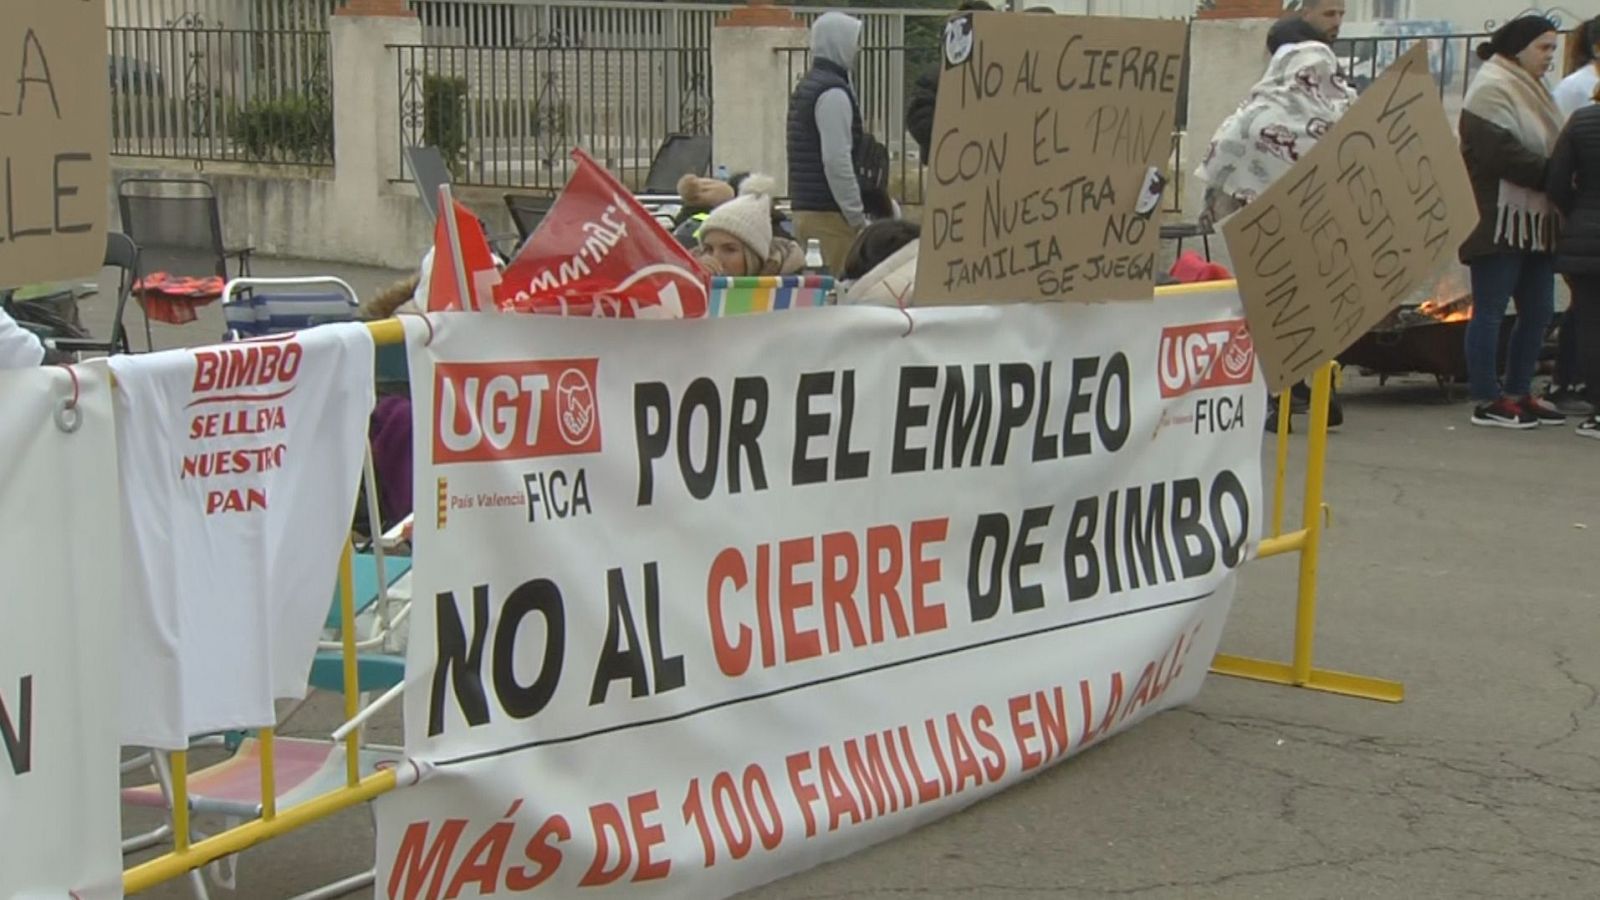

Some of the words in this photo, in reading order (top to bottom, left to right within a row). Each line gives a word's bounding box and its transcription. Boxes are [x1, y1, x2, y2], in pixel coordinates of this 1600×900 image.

[961, 40, 1004, 109] NO
[1013, 50, 1043, 96] AL
[1056, 35, 1181, 93] CIERRE
[934, 127, 1008, 186] CON
[1033, 107, 1070, 166] EL
[1086, 105, 1166, 166] PAN
[1376, 60, 1450, 262] VUESTRA
[932, 202, 966, 250] DE
[982, 176, 1116, 248] NUESTRA
[943, 235, 1063, 292] FAMILIA
[1102, 214, 1146, 247] NO
[1037, 265, 1079, 296] SE
[1082, 253, 1155, 282] JUEGA
[1287, 164, 1366, 344] NUESTRA
[192, 342, 304, 394] BIMBO
[1160, 330, 1231, 390] UGT
[189, 413, 220, 440] SE
[439, 373, 551, 453] UGT
[633, 375, 771, 507] POR
[791, 368, 871, 486] EL
[890, 351, 1132, 475] EMPLEO
[1194, 394, 1245, 435] FICA
[206, 487, 268, 515] PAN
[522, 467, 593, 523] FICA
[426, 577, 567, 739] NO
[588, 561, 687, 707] AL
[706, 517, 950, 679] CIERRE
[966, 504, 1056, 624] DE
[1062, 468, 1250, 603] BIMBO
[386, 798, 573, 900] MÁS
[576, 788, 673, 888] DE
[680, 762, 785, 869] 100
[784, 703, 1007, 840] FAMILIAS
[1007, 685, 1070, 772] EN
